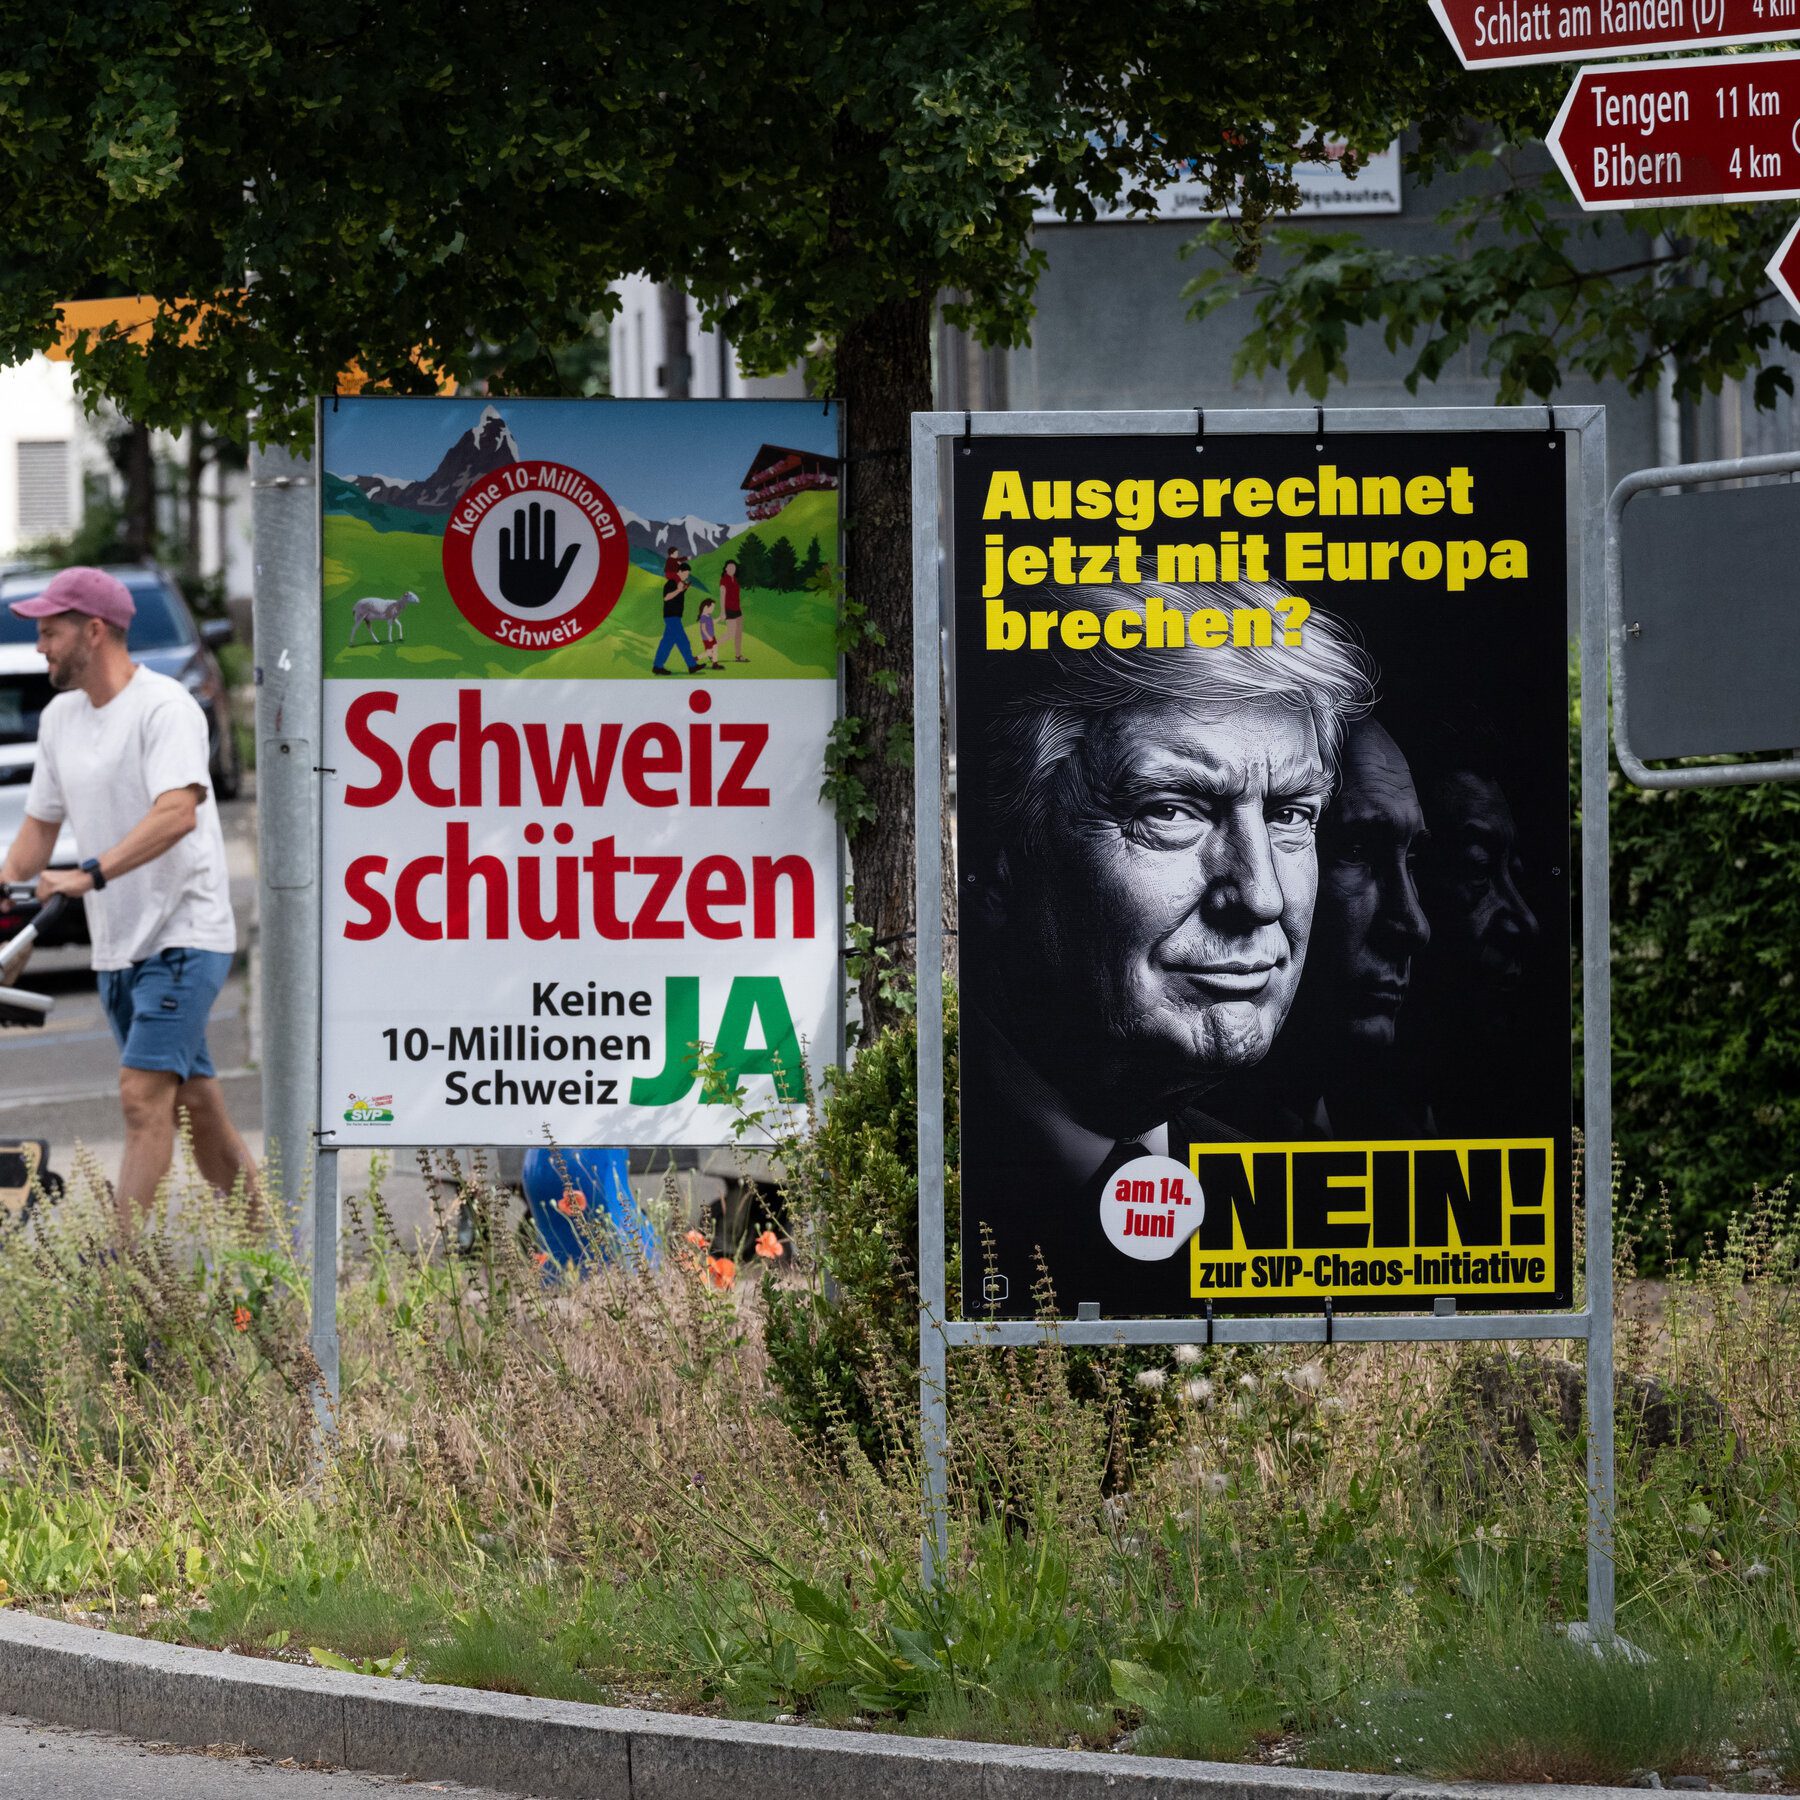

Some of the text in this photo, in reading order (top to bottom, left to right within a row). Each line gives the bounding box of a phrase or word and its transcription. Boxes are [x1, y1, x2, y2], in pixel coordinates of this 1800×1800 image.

[1474, 0, 1551, 47] Schlatt
[1558, 5, 1592, 38] am
[1600, 0, 1684, 34] Randen
[1692, 0, 1725, 33] (D)
[1752, 0, 1764, 18] 4
[1591, 83, 1780, 136] Tengen 11 km
[1594, 142, 1782, 188] Bibern 4 km
[451, 465, 617, 540] Keine 10-Millionen
[982, 464, 1474, 531] Ausgerechnet
[982, 531, 1529, 598] jetzt mit Europa
[495, 618, 582, 646] Schweiz
[985, 597, 1311, 651] brechen?
[343, 689, 771, 808] Schweiz
[343, 822, 816, 941] schützen
[532, 982, 652, 1017] Keine
[382, 1025, 651, 1062] 10-Millionen
[629, 975, 807, 1107] JA
[444, 1070, 618, 1106] Schweiz
[351, 1110, 383, 1121] SVP
[1115, 1177, 1192, 1206] am 14.
[1199, 1147, 1547, 1251] NEIN!
[1124, 1208, 1175, 1238] Juni
[1199, 1253, 1546, 1289] zur SVP-Chaos-Initiative
